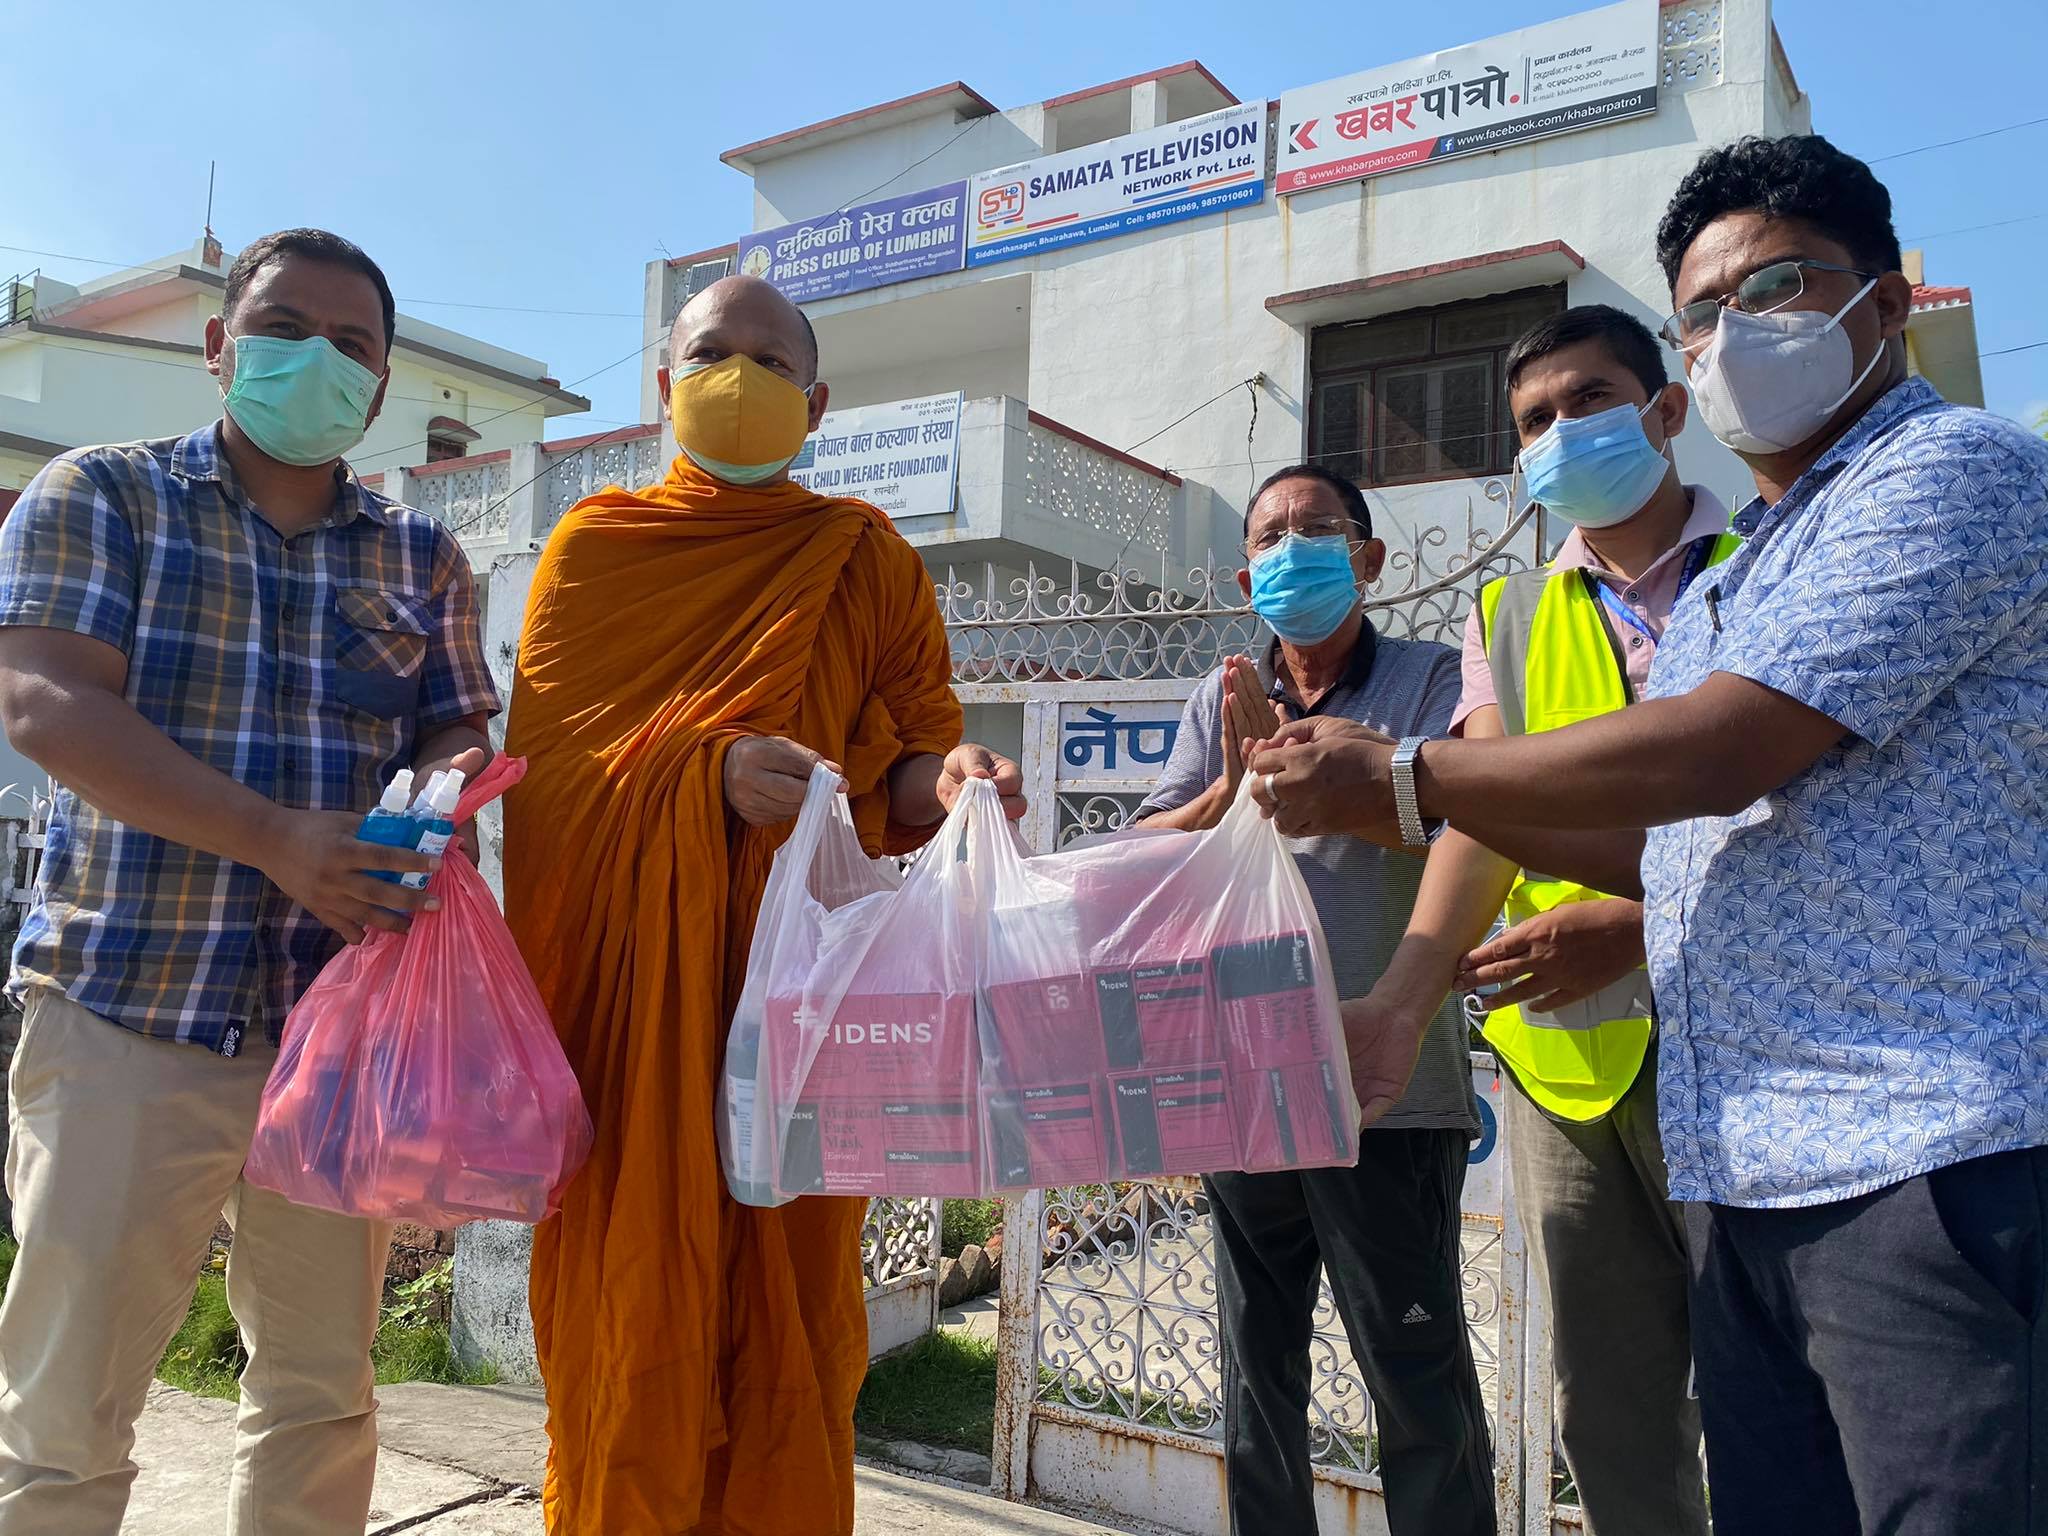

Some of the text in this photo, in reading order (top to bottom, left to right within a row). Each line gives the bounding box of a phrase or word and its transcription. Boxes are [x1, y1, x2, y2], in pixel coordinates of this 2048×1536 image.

[1456, 94, 1642, 147] www.facebook.com/khabarpatro1
[1029, 120, 1259, 199] SAMATA TELEVISION
[1122, 153, 1255, 196] NETWORK Pvt. Ltd.
[1309, 148, 1418, 181] www.khabarpatro.com
[776, 196, 959, 261] लुम्बिनी प्रेस क्लब
[975, 239, 1038, 260] Siddharthanagar,
[1039, 228, 1087, 246] Bhairahawa,
[1088, 220, 1120, 235] Lumbini
[1146, 201, 1200, 221] 9857015969,
[1201, 188, 1254, 208] 9857010601
[773, 224, 955, 282] PRESS CLUB OF LUMBINI
[817, 419, 954, 458] नेपाल बाल कल्याण संस्था
[789, 454, 949, 490] EPAL CHILD WELFARE FOUNDATION
[820, 1022, 933, 1045] IDENS
[1123, 1087, 1147, 1096] FIDENS
[1402, 1313, 1432, 1324] adidas
